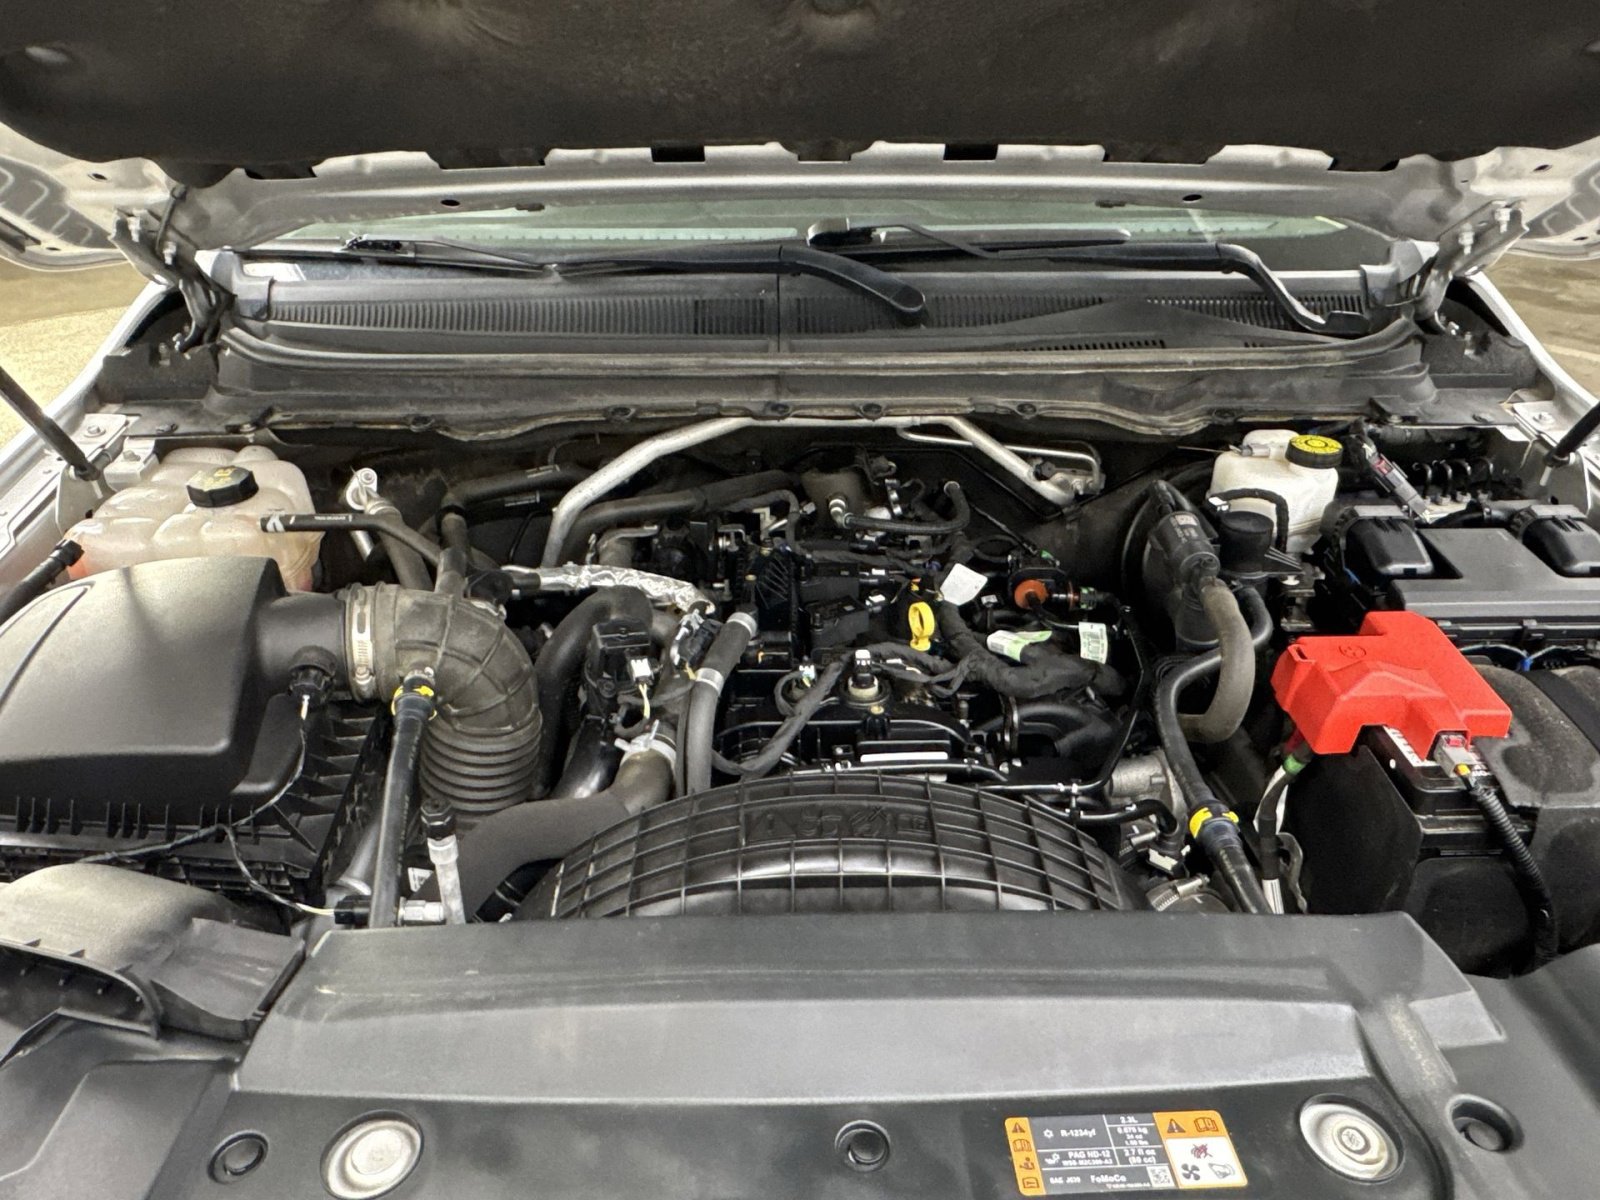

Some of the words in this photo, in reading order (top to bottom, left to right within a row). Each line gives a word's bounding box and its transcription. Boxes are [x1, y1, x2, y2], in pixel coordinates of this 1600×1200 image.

[1120, 1116, 1138, 1124] 2.3L
[1068, 1151, 1086, 1159] PAG
[1090, 1174, 1127, 1183] FoMoCo
